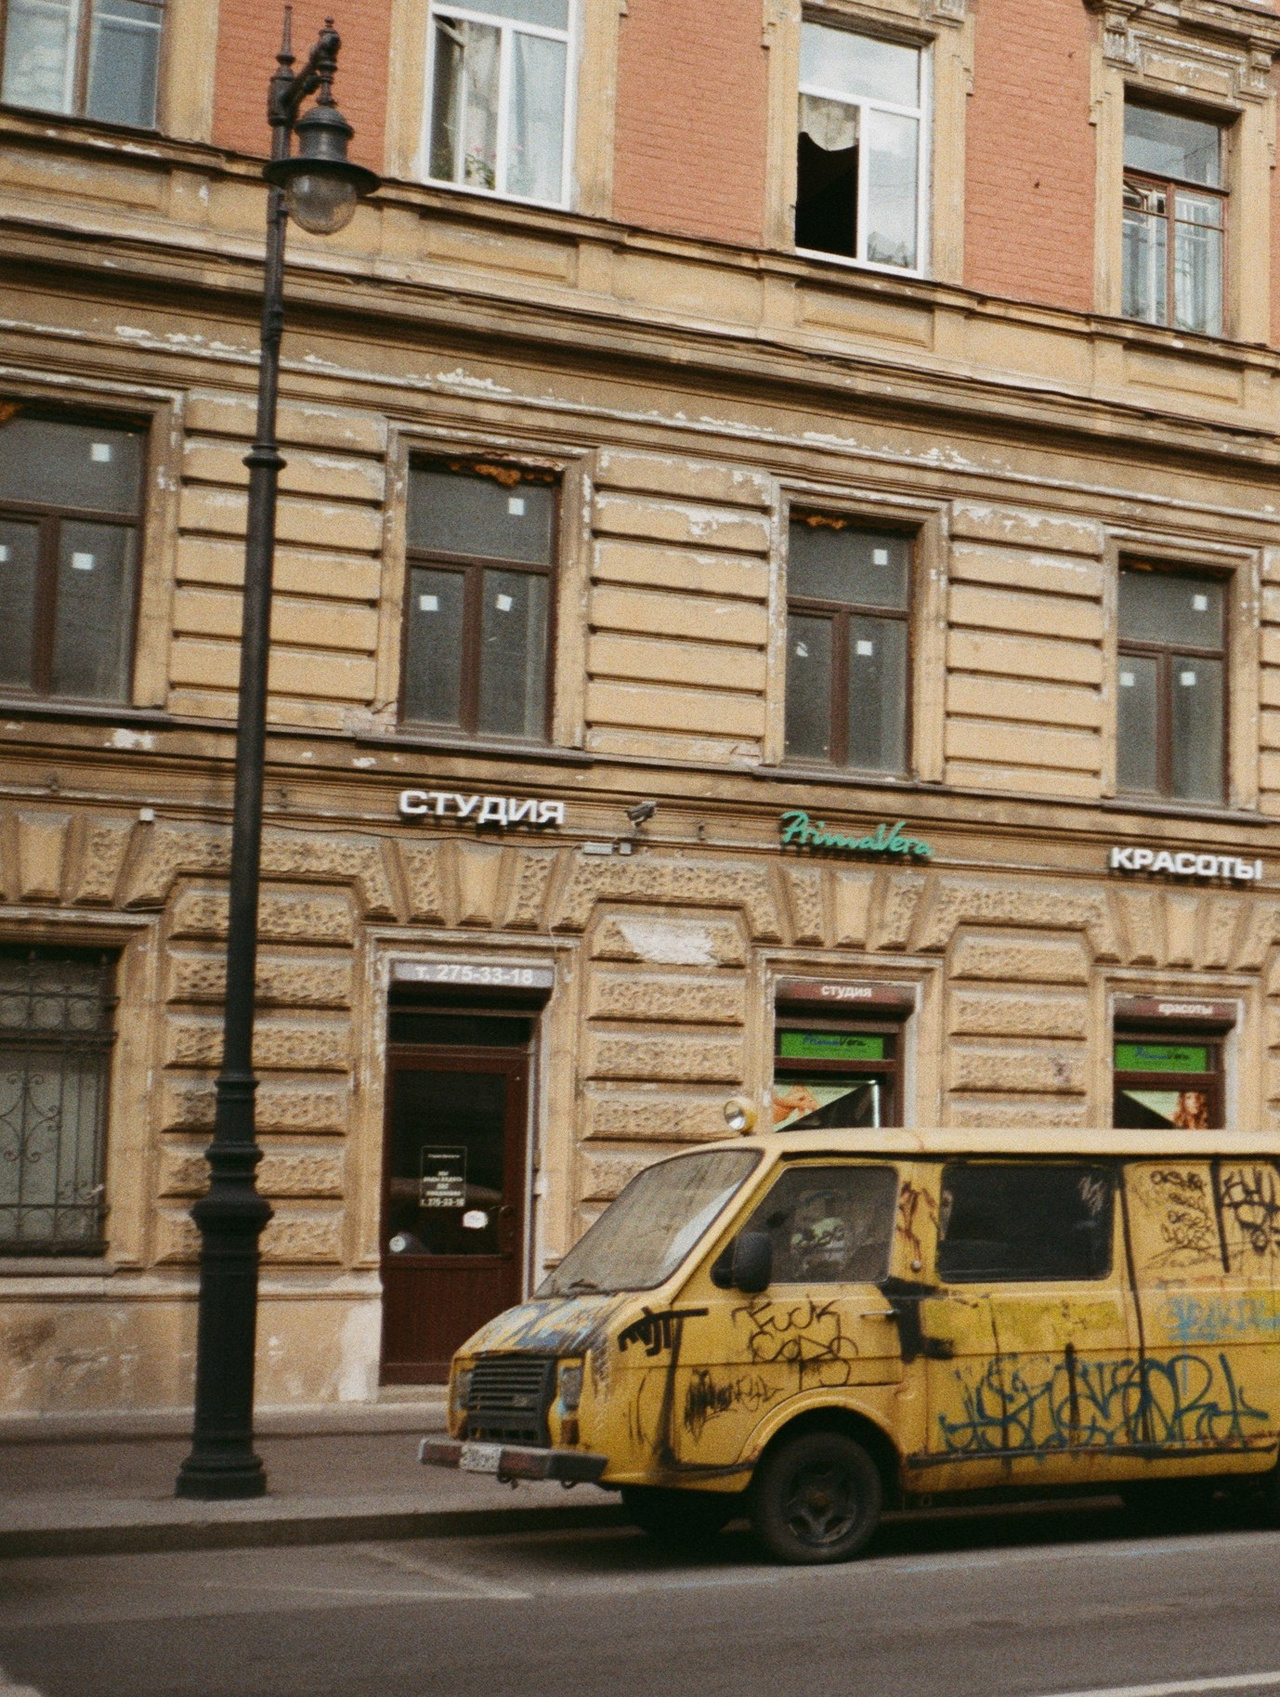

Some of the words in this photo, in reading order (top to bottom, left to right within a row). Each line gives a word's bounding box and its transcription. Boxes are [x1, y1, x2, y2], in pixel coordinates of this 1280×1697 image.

[400, 790, 565, 826] СТУДИЯ
[779, 810, 934, 855] PrimaVera
[1110, 847, 1263, 880] КРАСОТЫ
[437, 964, 534, 985] 275-33-18
[821, 985, 873, 999] студия
[1158, 1003, 1214, 1016] красоты
